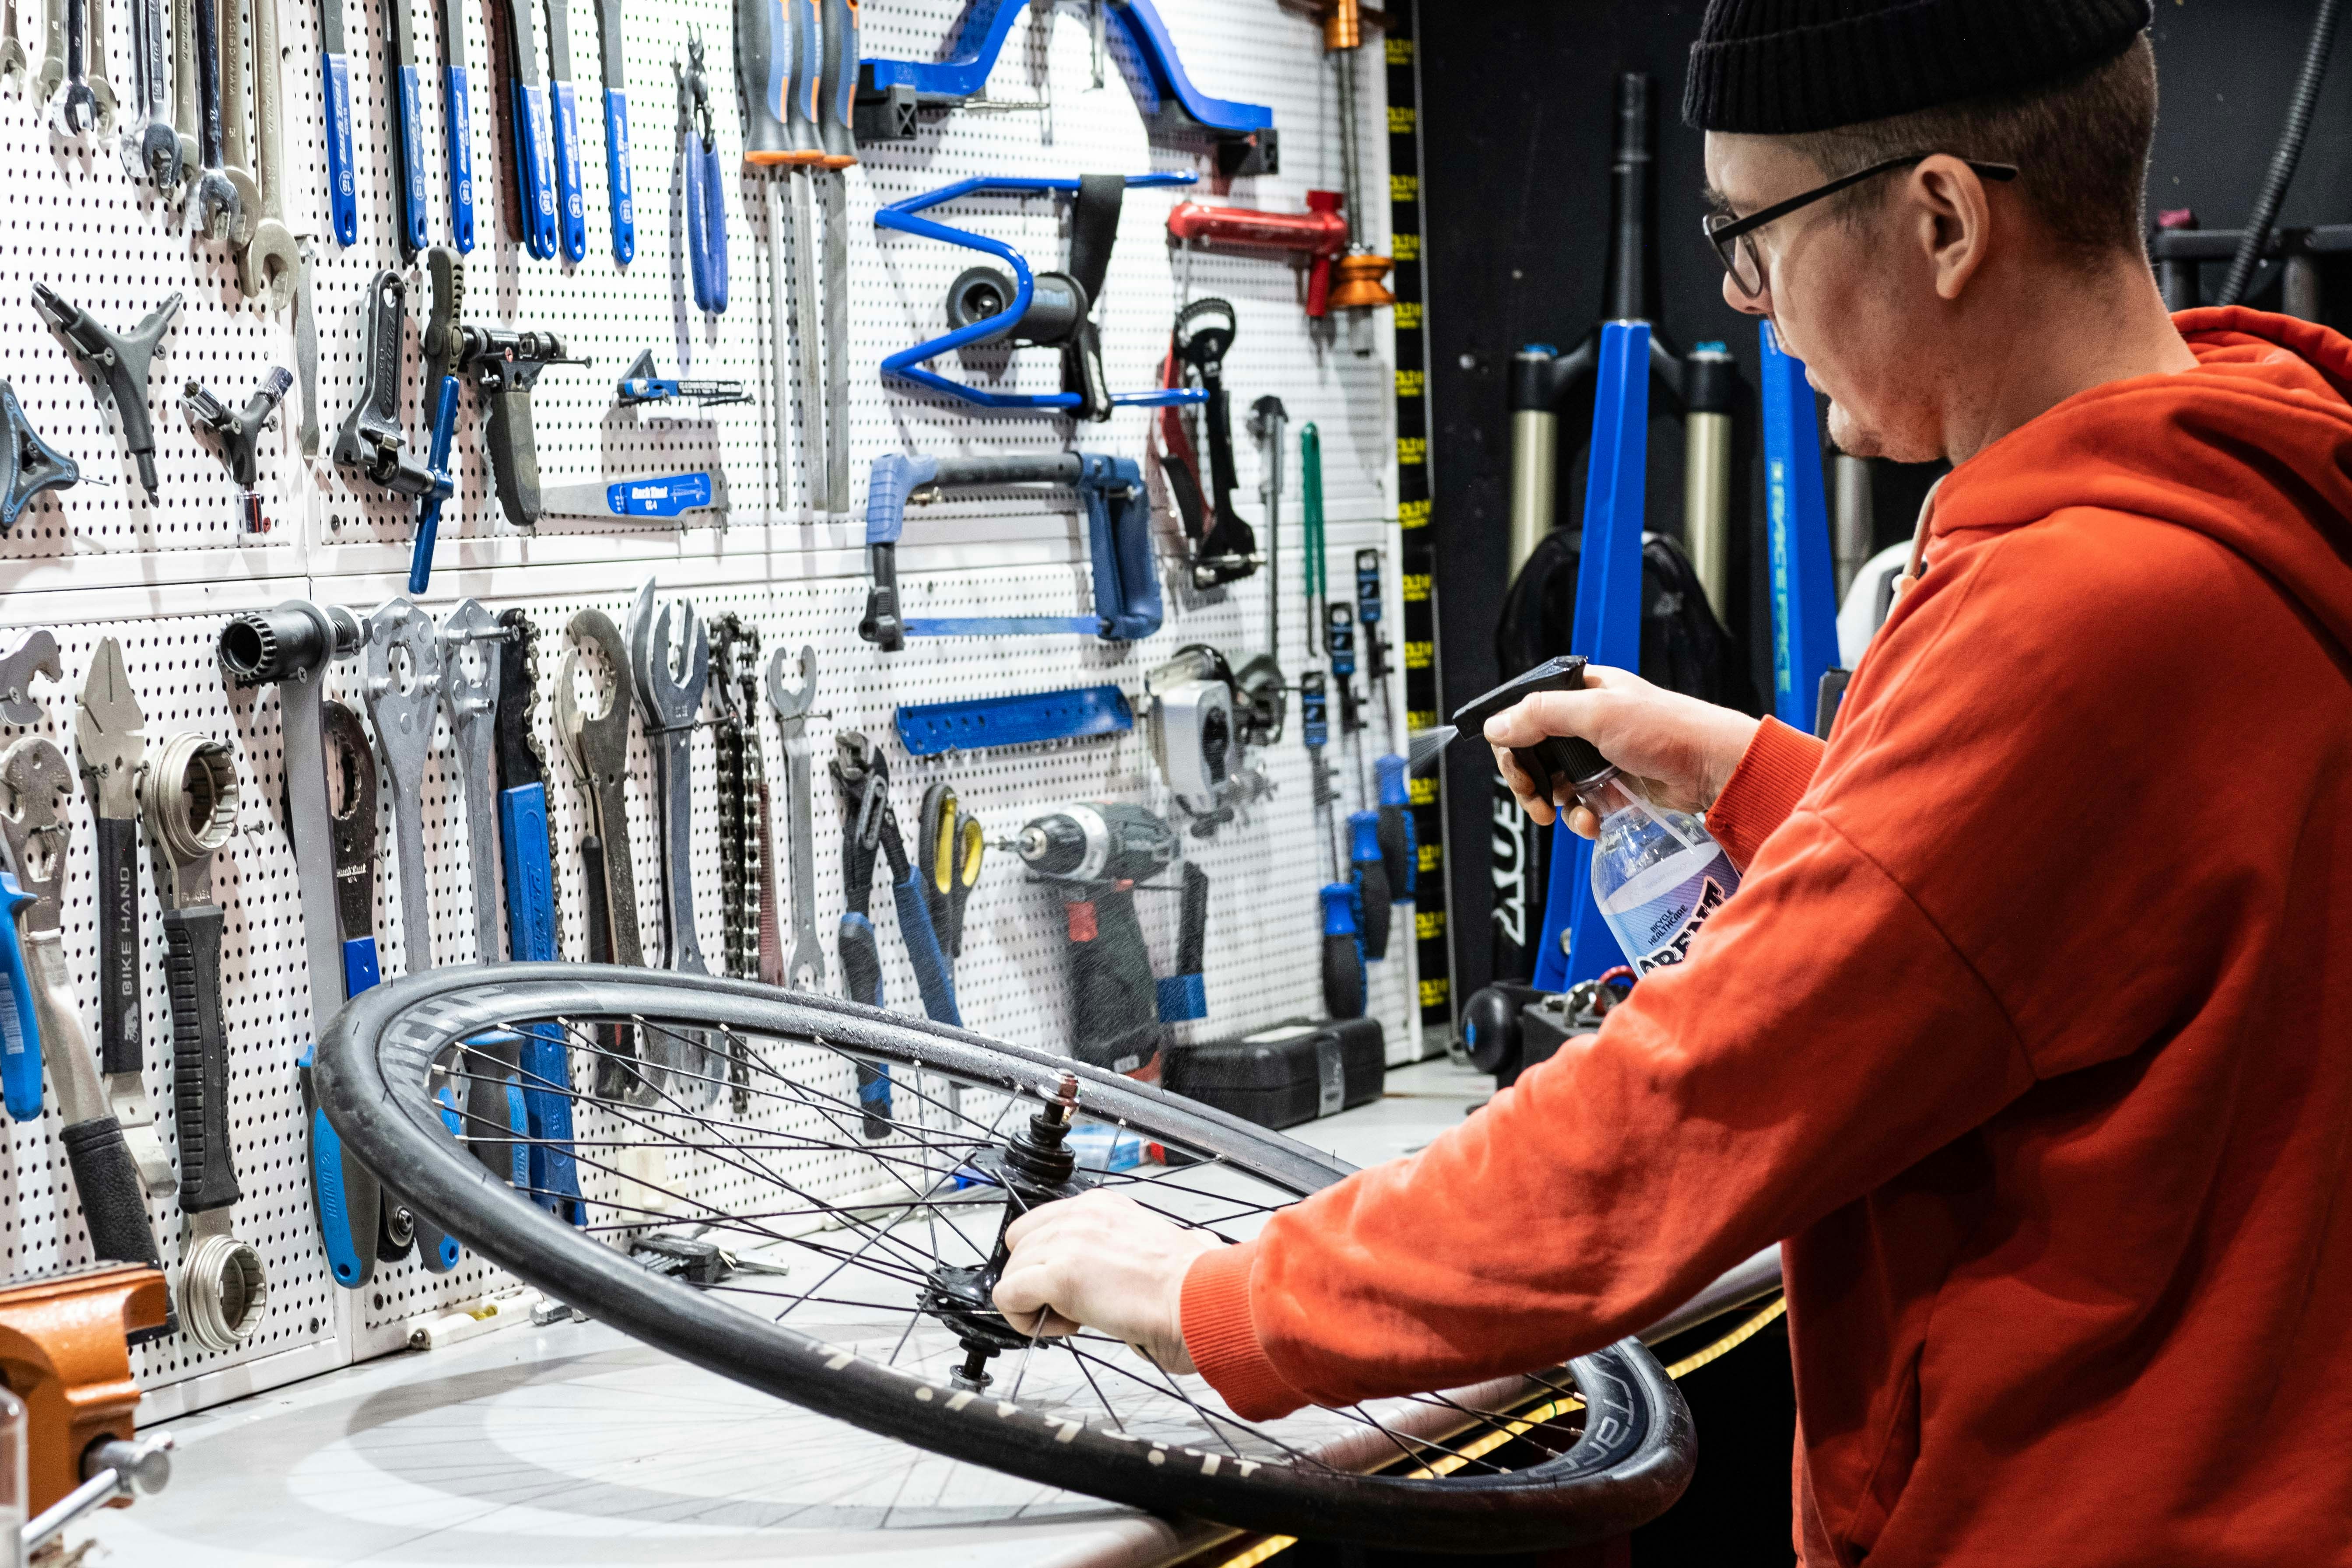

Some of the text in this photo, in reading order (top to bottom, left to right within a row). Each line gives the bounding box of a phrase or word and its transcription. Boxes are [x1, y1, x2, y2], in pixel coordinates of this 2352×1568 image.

[333, 77, 347, 164] Park Tool
[342, 179, 351, 193] 19
[120, 867, 132, 996] BIKE HAND
[1648, 905, 1688, 946] HEALTHCARE
[1650, 909, 1674, 933] BICYCLE
